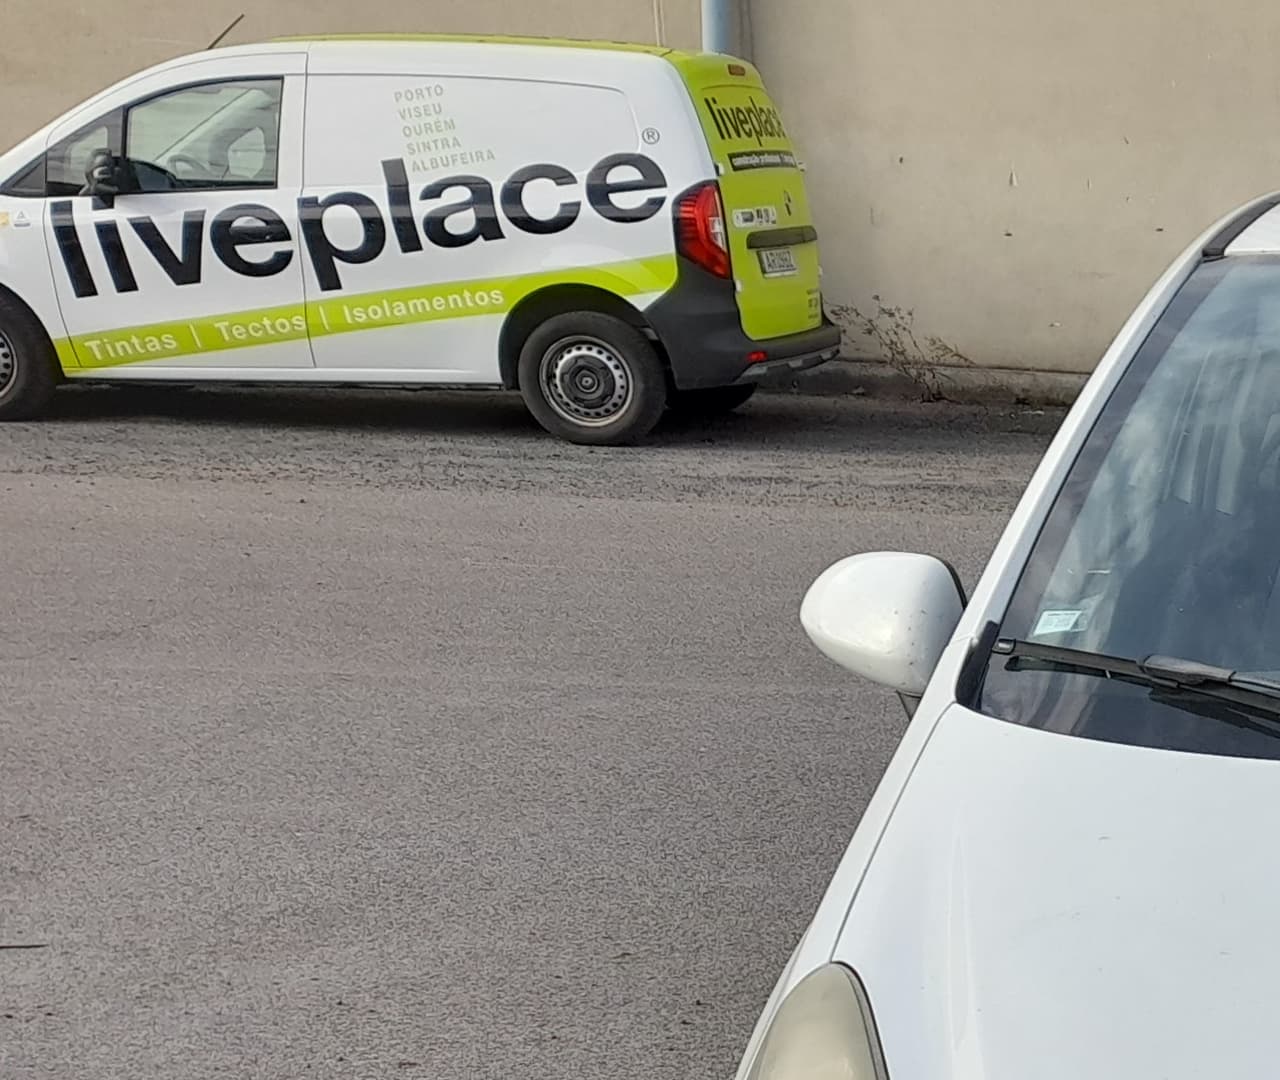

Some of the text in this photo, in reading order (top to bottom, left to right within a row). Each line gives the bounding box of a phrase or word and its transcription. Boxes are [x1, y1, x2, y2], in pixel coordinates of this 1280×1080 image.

[394, 84, 444, 102] PORTO
[398, 103, 443, 120] VISEU
[406, 136, 462, 155] SINTRA
[412, 149, 496, 172] ALBUFEIRA
[50, 152, 668, 298] liveplace
[84, 288, 504, 362] Tintas Tectos Isolamentos
